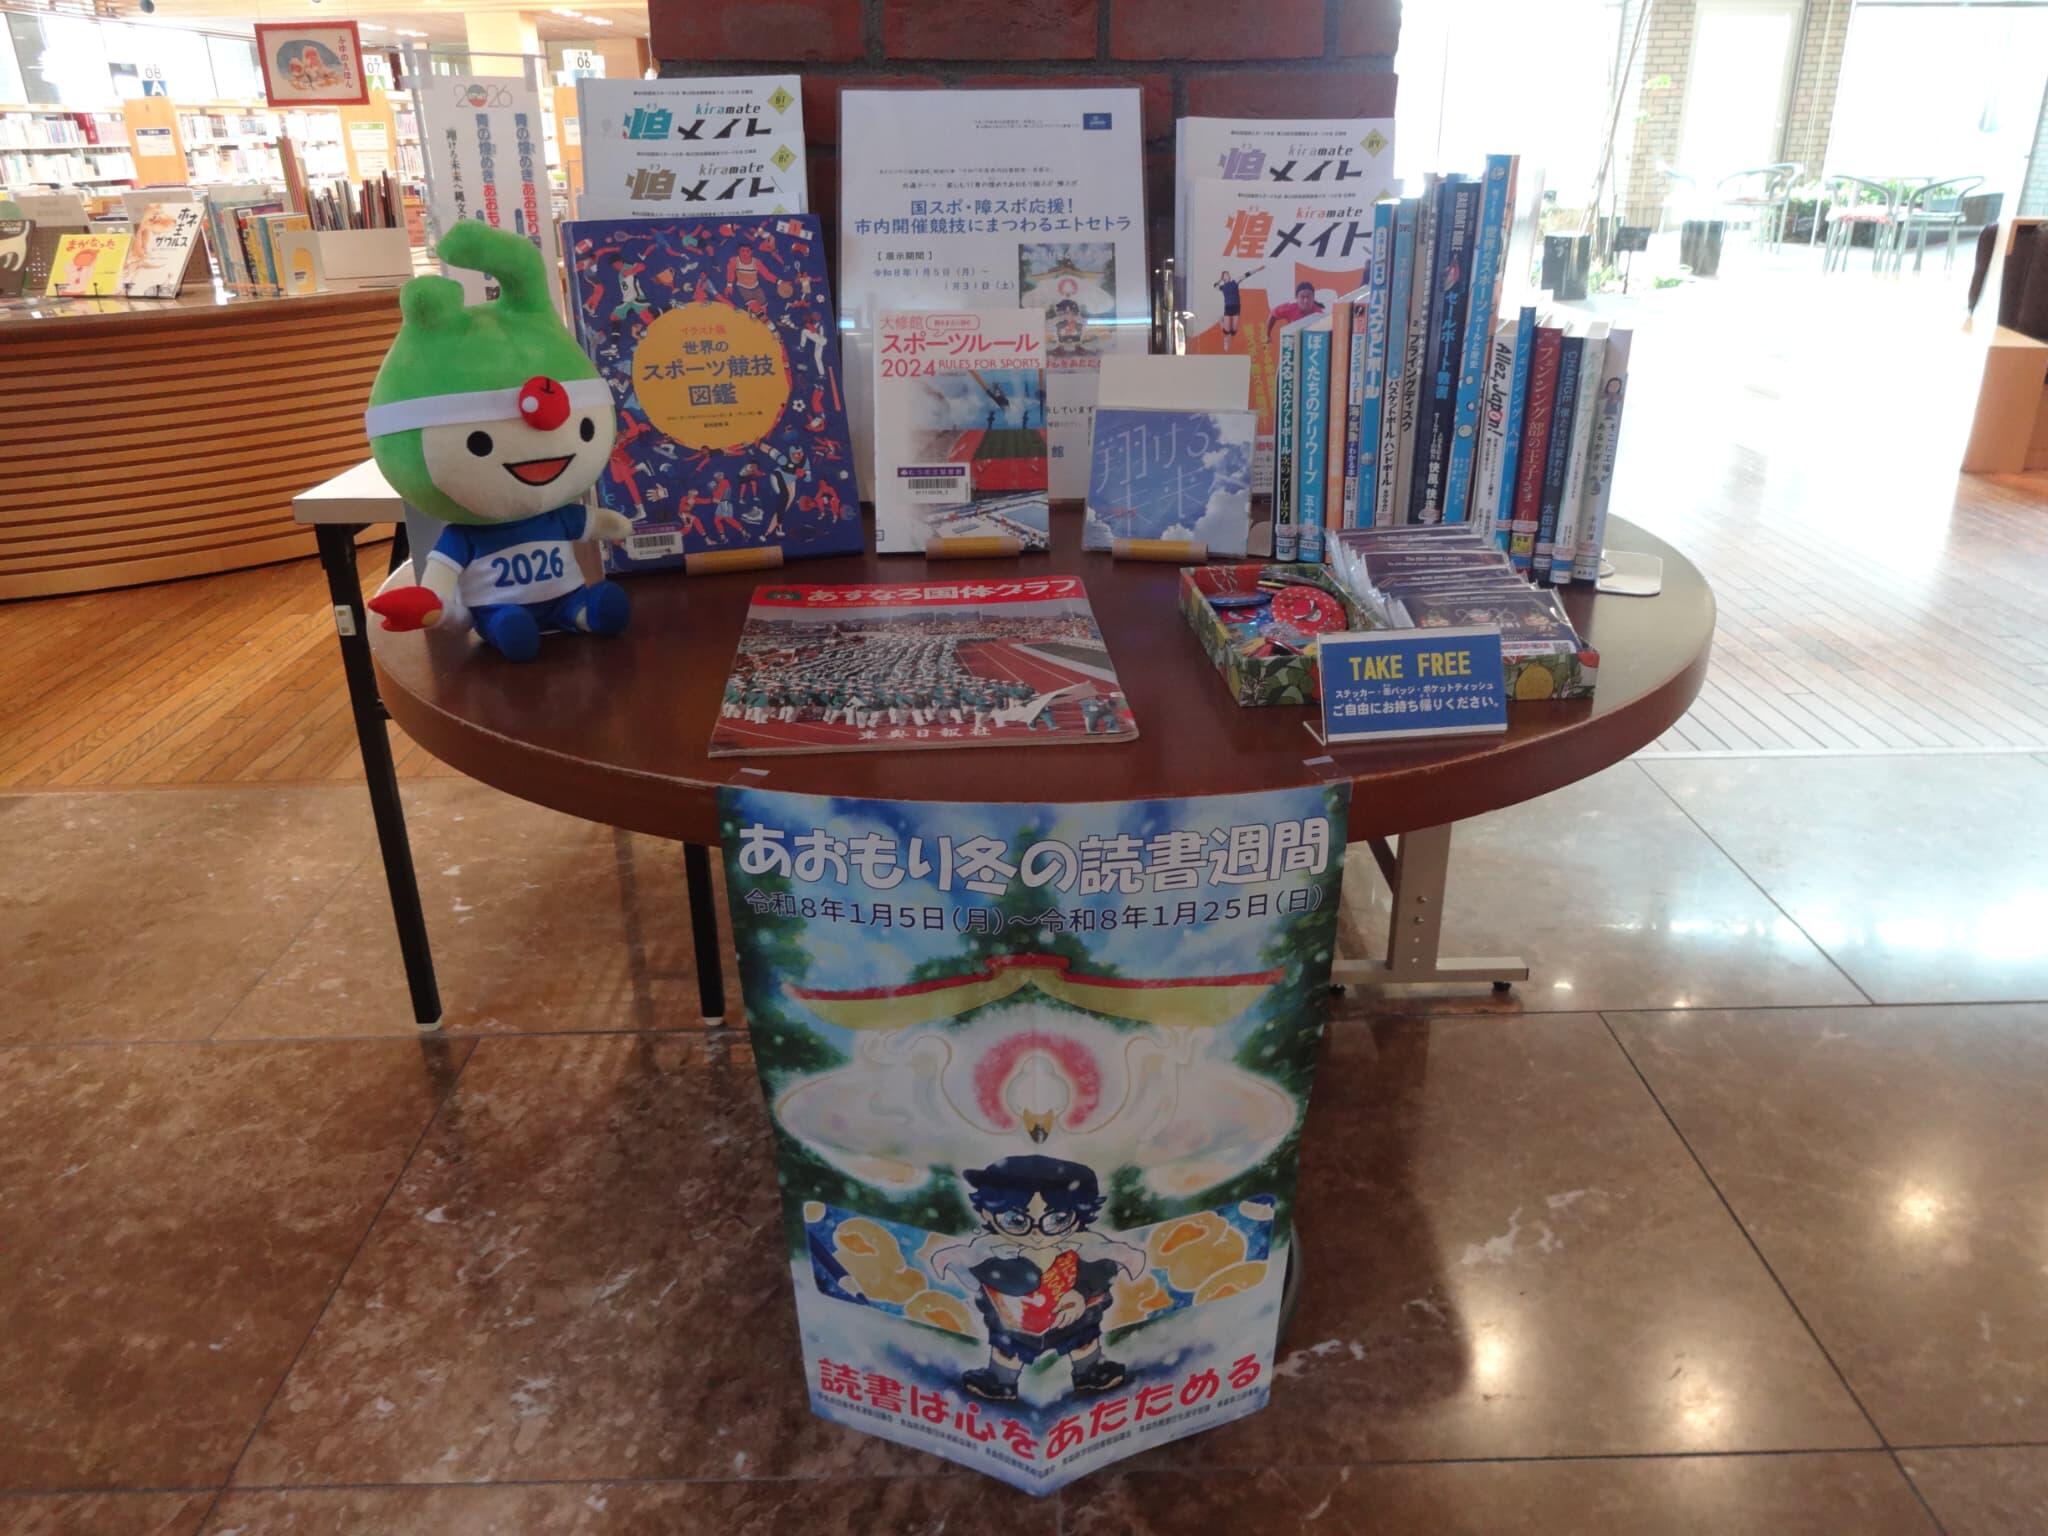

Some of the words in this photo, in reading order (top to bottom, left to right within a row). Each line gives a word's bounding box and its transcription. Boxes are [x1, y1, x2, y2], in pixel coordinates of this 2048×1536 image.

[367, 62, 381, 74] 07
[577, 56, 591, 69] 06
[695, 102, 761, 115] kiramate
[1288, 144, 1353, 157] kiramate
[476, 113, 500, 228] 青の煌めきあおも
[699, 163, 764, 176] kiramate
[911, 198, 1074, 216] 国スポ・障スポ応援!
[1296, 206, 1363, 219] kiramate
[854, 216, 1132, 234] 市内開催競技にまつわるエトセトラ
[1222, 209, 1373, 258] 煌メイト
[880, 315, 924, 330] 大修館
[682, 340, 729, 355] 世界の
[881, 331, 1040, 355] スポーツルール
[642, 353, 776, 381] スポーツ競技
[881, 358, 936, 378] 2024
[938, 359, 970, 370] RULES
[974, 359, 997, 369] FOR
[1000, 358, 1041, 369] SPORTS
[688, 382, 739, 406] 図鑑
[1402, 334, 1418, 432] フライングディスク
[1305, 335, 1322, 484] ぼくたちのアリウープ
[1487, 383, 1508, 438] Japon!
[1381, 441, 1396, 486] ハンドボール
[491, 547, 563, 588] 2026
[807, 578, 1077, 602] あすなろ国体グラフ
[1349, 655, 1403, 681] TAKE
[1417, 651, 1472, 678] FREE
[1333, 695, 1500, 717] ご自由にお持ち帰りください。
[738, 816, 1332, 897] あおもり冬の読書週間
[817, 1352, 1263, 1462] 読書は心をあたためる
